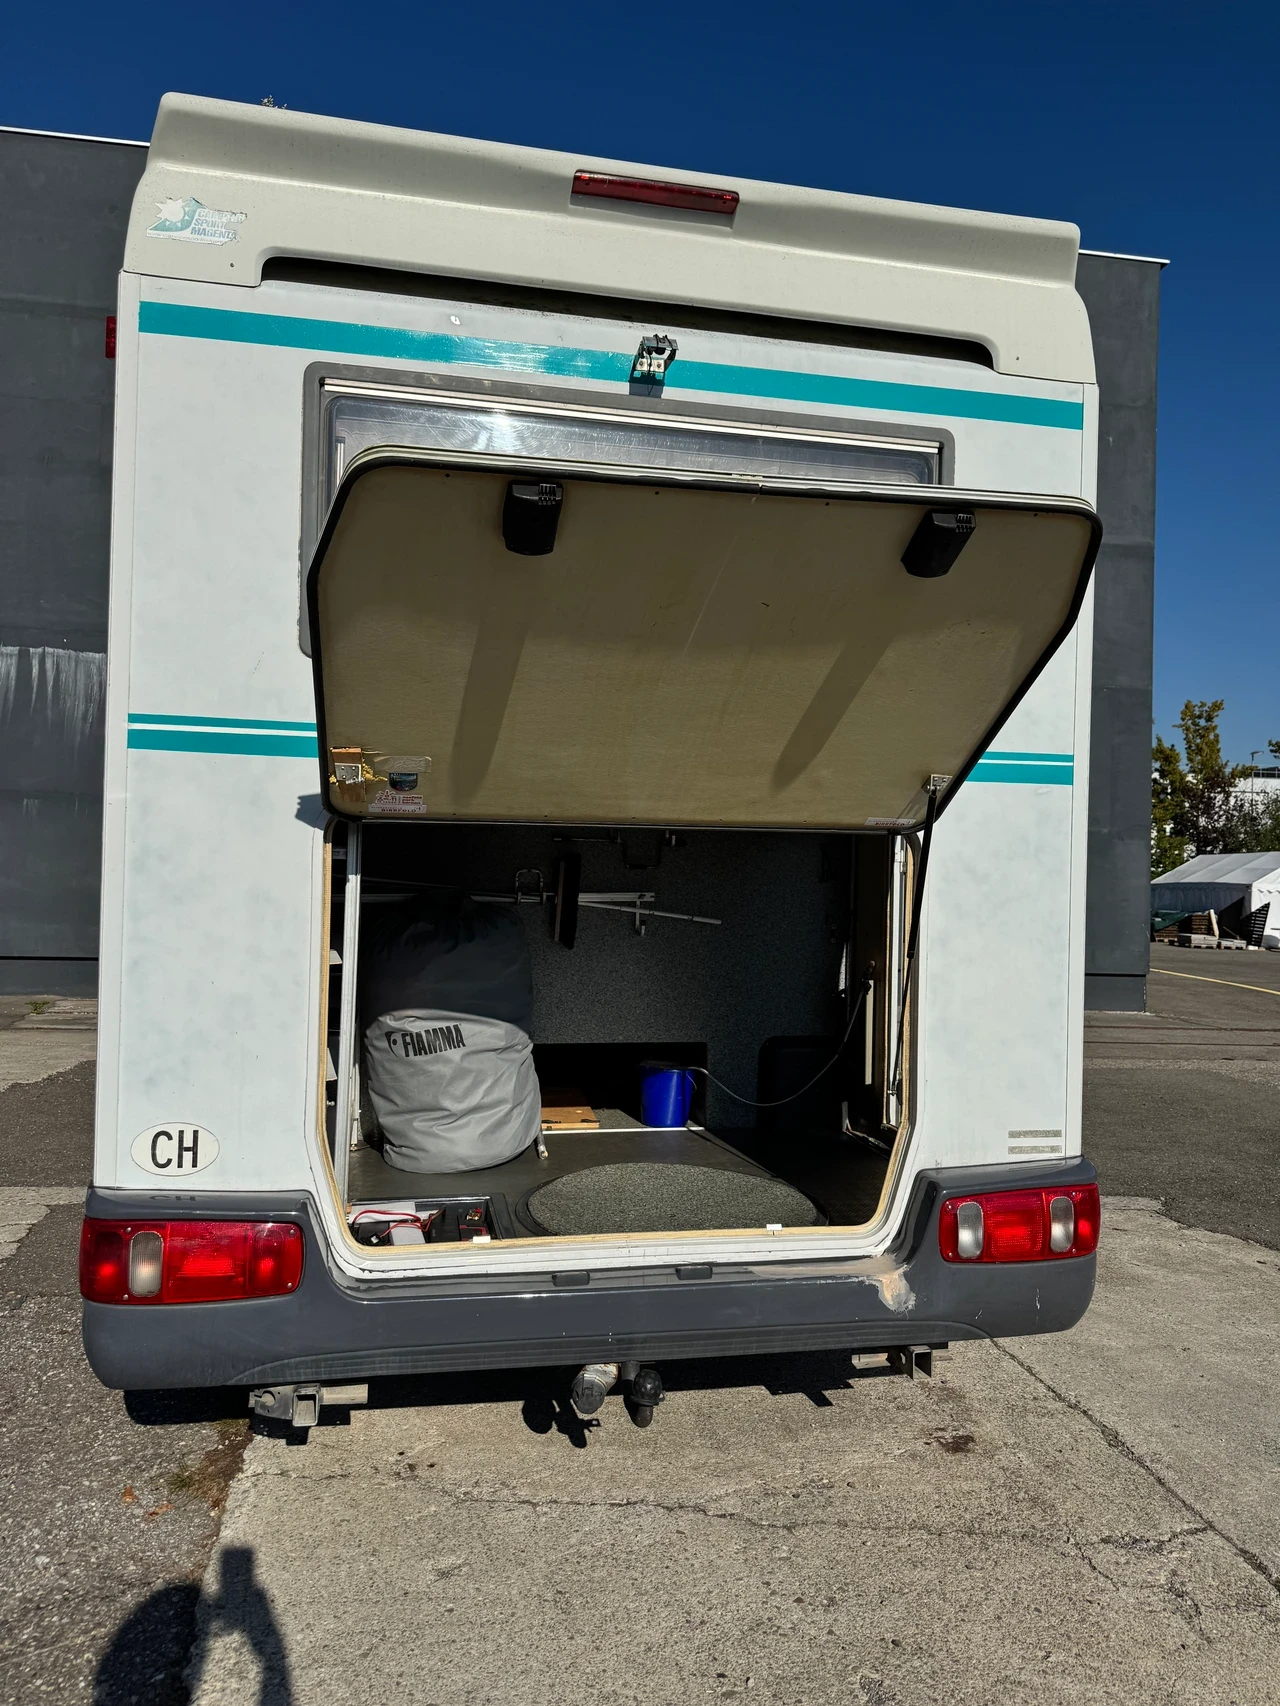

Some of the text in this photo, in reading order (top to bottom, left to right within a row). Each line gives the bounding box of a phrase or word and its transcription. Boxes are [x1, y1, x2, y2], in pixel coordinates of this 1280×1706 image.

[193, 217, 225, 229] SPORT
[401, 1023, 466, 1057] FIAMMA
[150, 1129, 199, 1169] CH
